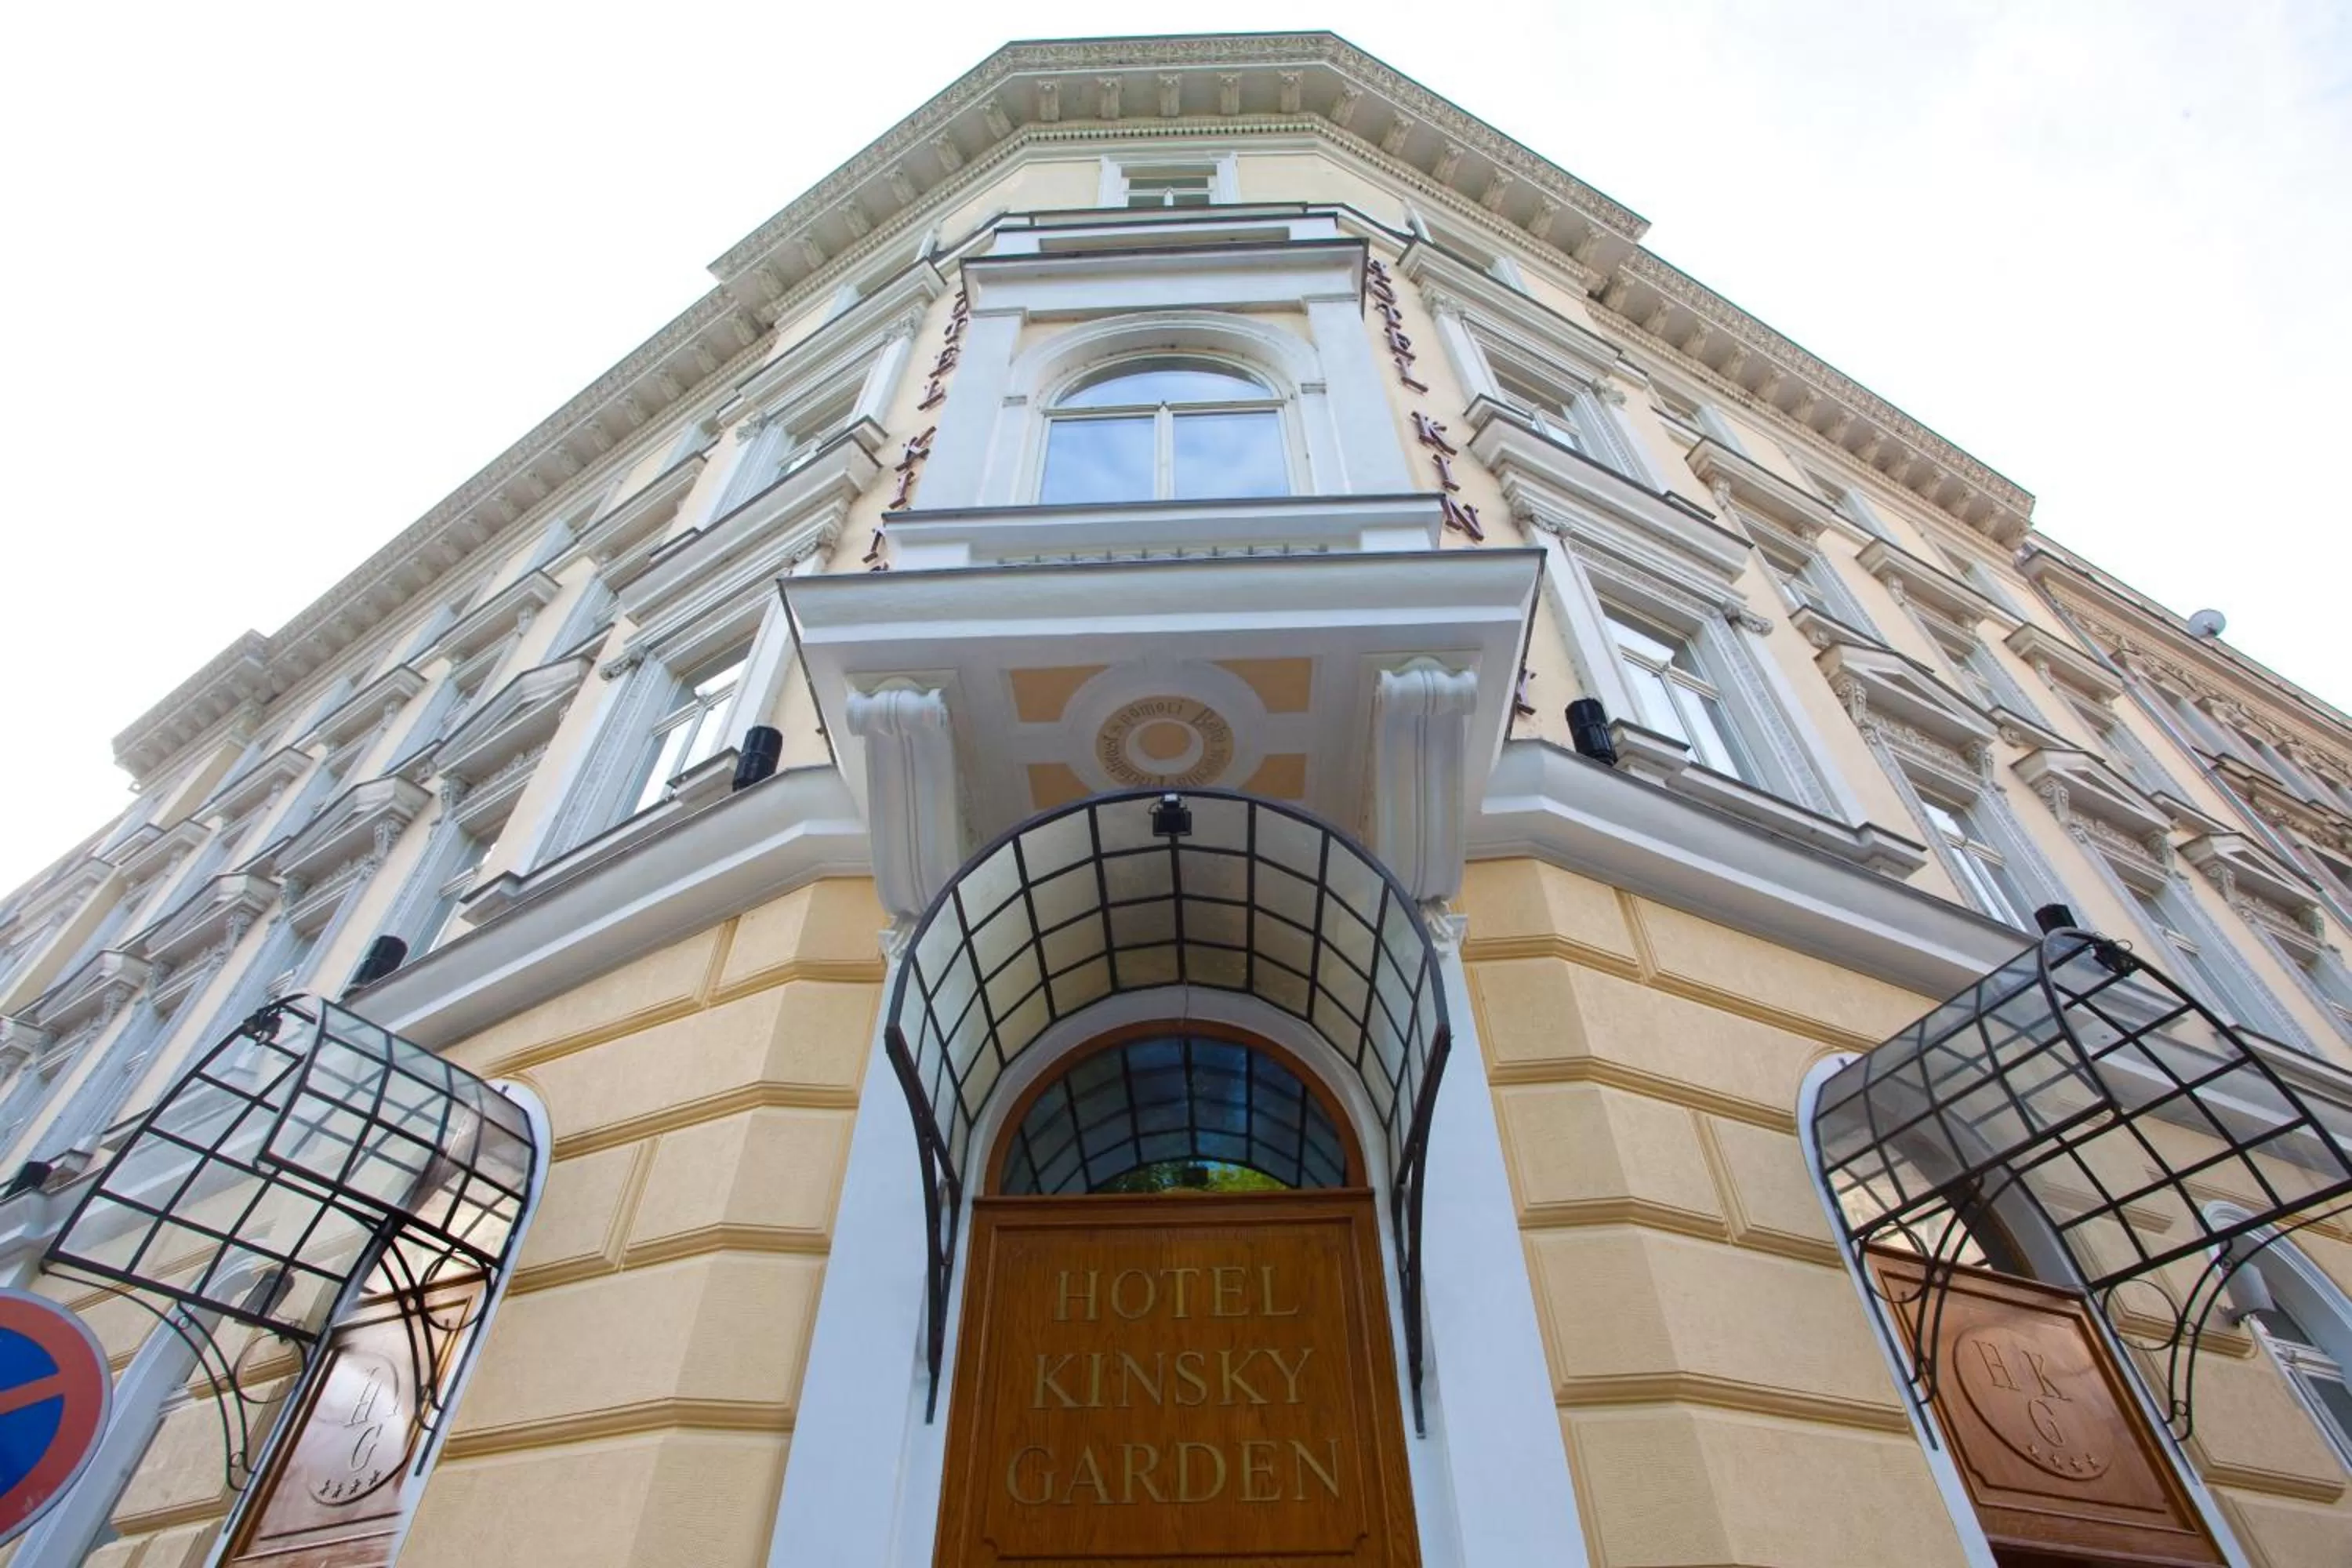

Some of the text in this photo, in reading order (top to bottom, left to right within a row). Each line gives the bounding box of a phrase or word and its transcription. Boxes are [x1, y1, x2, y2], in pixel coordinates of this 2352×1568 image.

[1053, 1265, 1300, 1323] HOTEL
[1032, 1347, 1316, 1410] KINSKY
[1005, 1439, 1341, 1506] GARDEN
